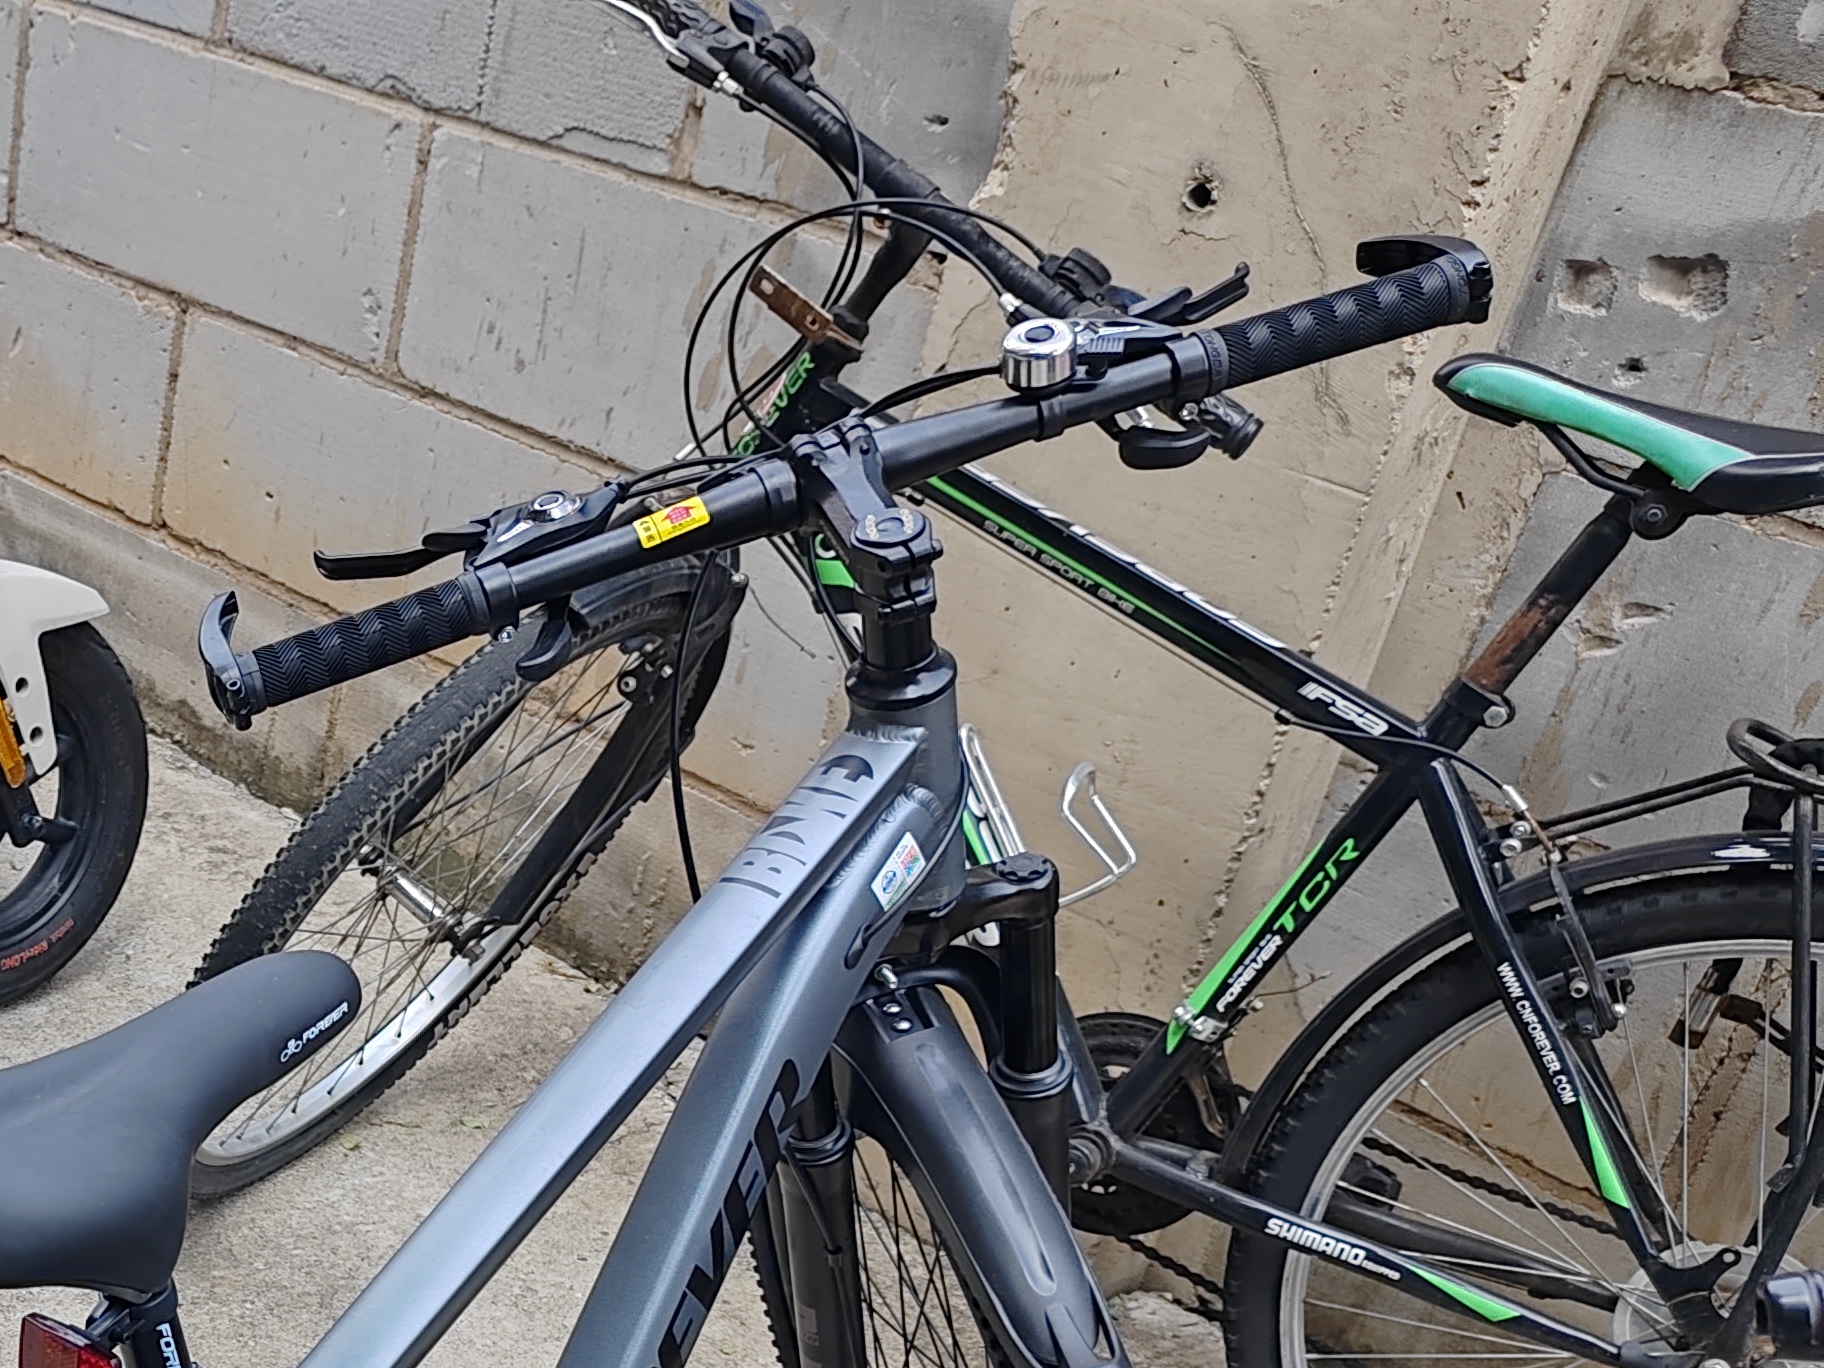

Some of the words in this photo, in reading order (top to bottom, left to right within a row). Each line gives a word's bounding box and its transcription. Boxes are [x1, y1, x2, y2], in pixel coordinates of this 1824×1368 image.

[1273, 837, 1360, 933] TCR
[1215, 934, 1284, 1013] FOREVER
[1264, 1217, 1367, 1267] SHIMANO
